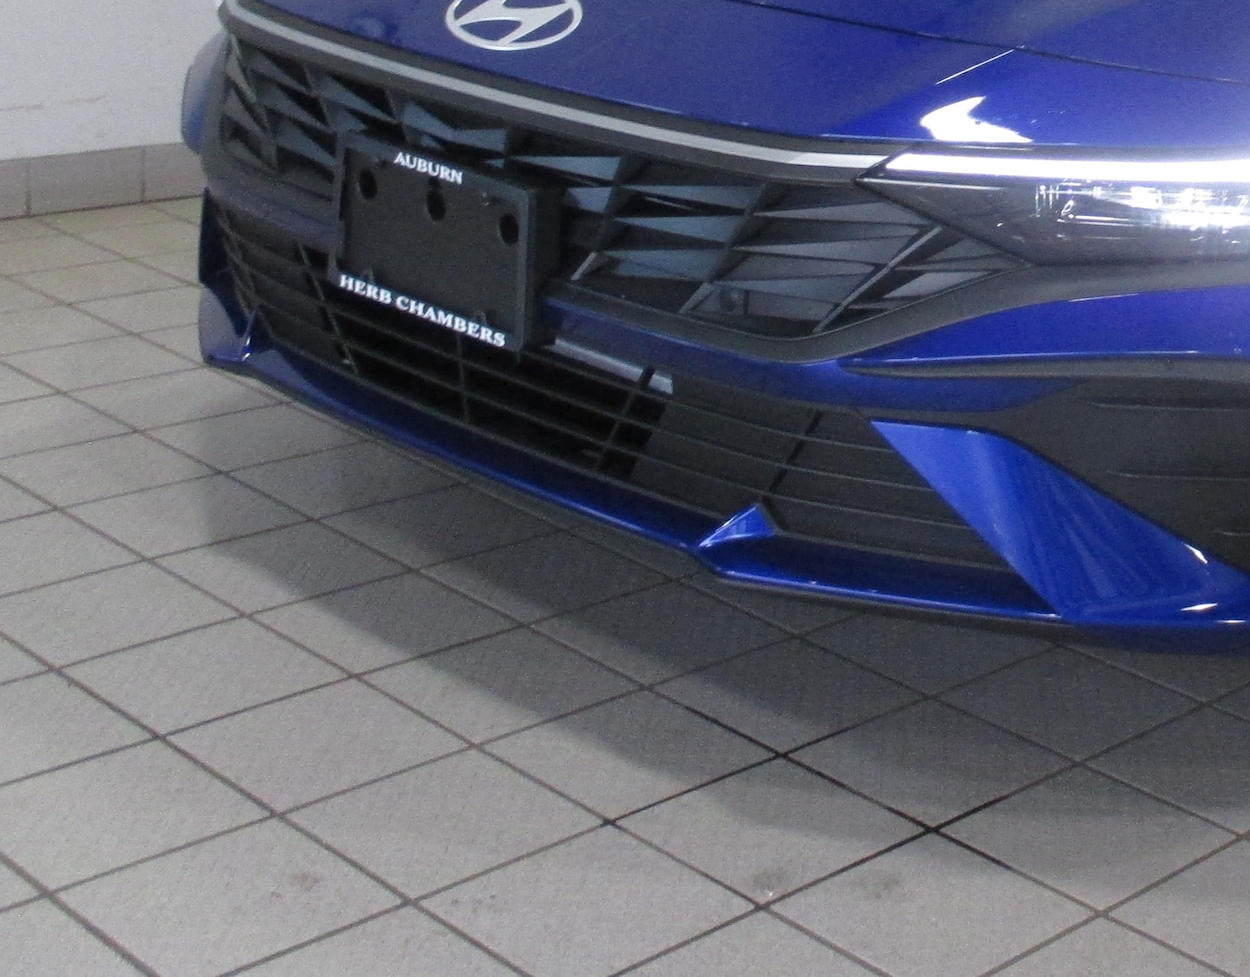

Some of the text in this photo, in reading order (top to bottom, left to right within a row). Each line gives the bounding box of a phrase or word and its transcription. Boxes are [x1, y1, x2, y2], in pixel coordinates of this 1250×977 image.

[393, 151, 463, 185] AUBURN
[339, 274, 506, 347] HERB CHAMBERS
